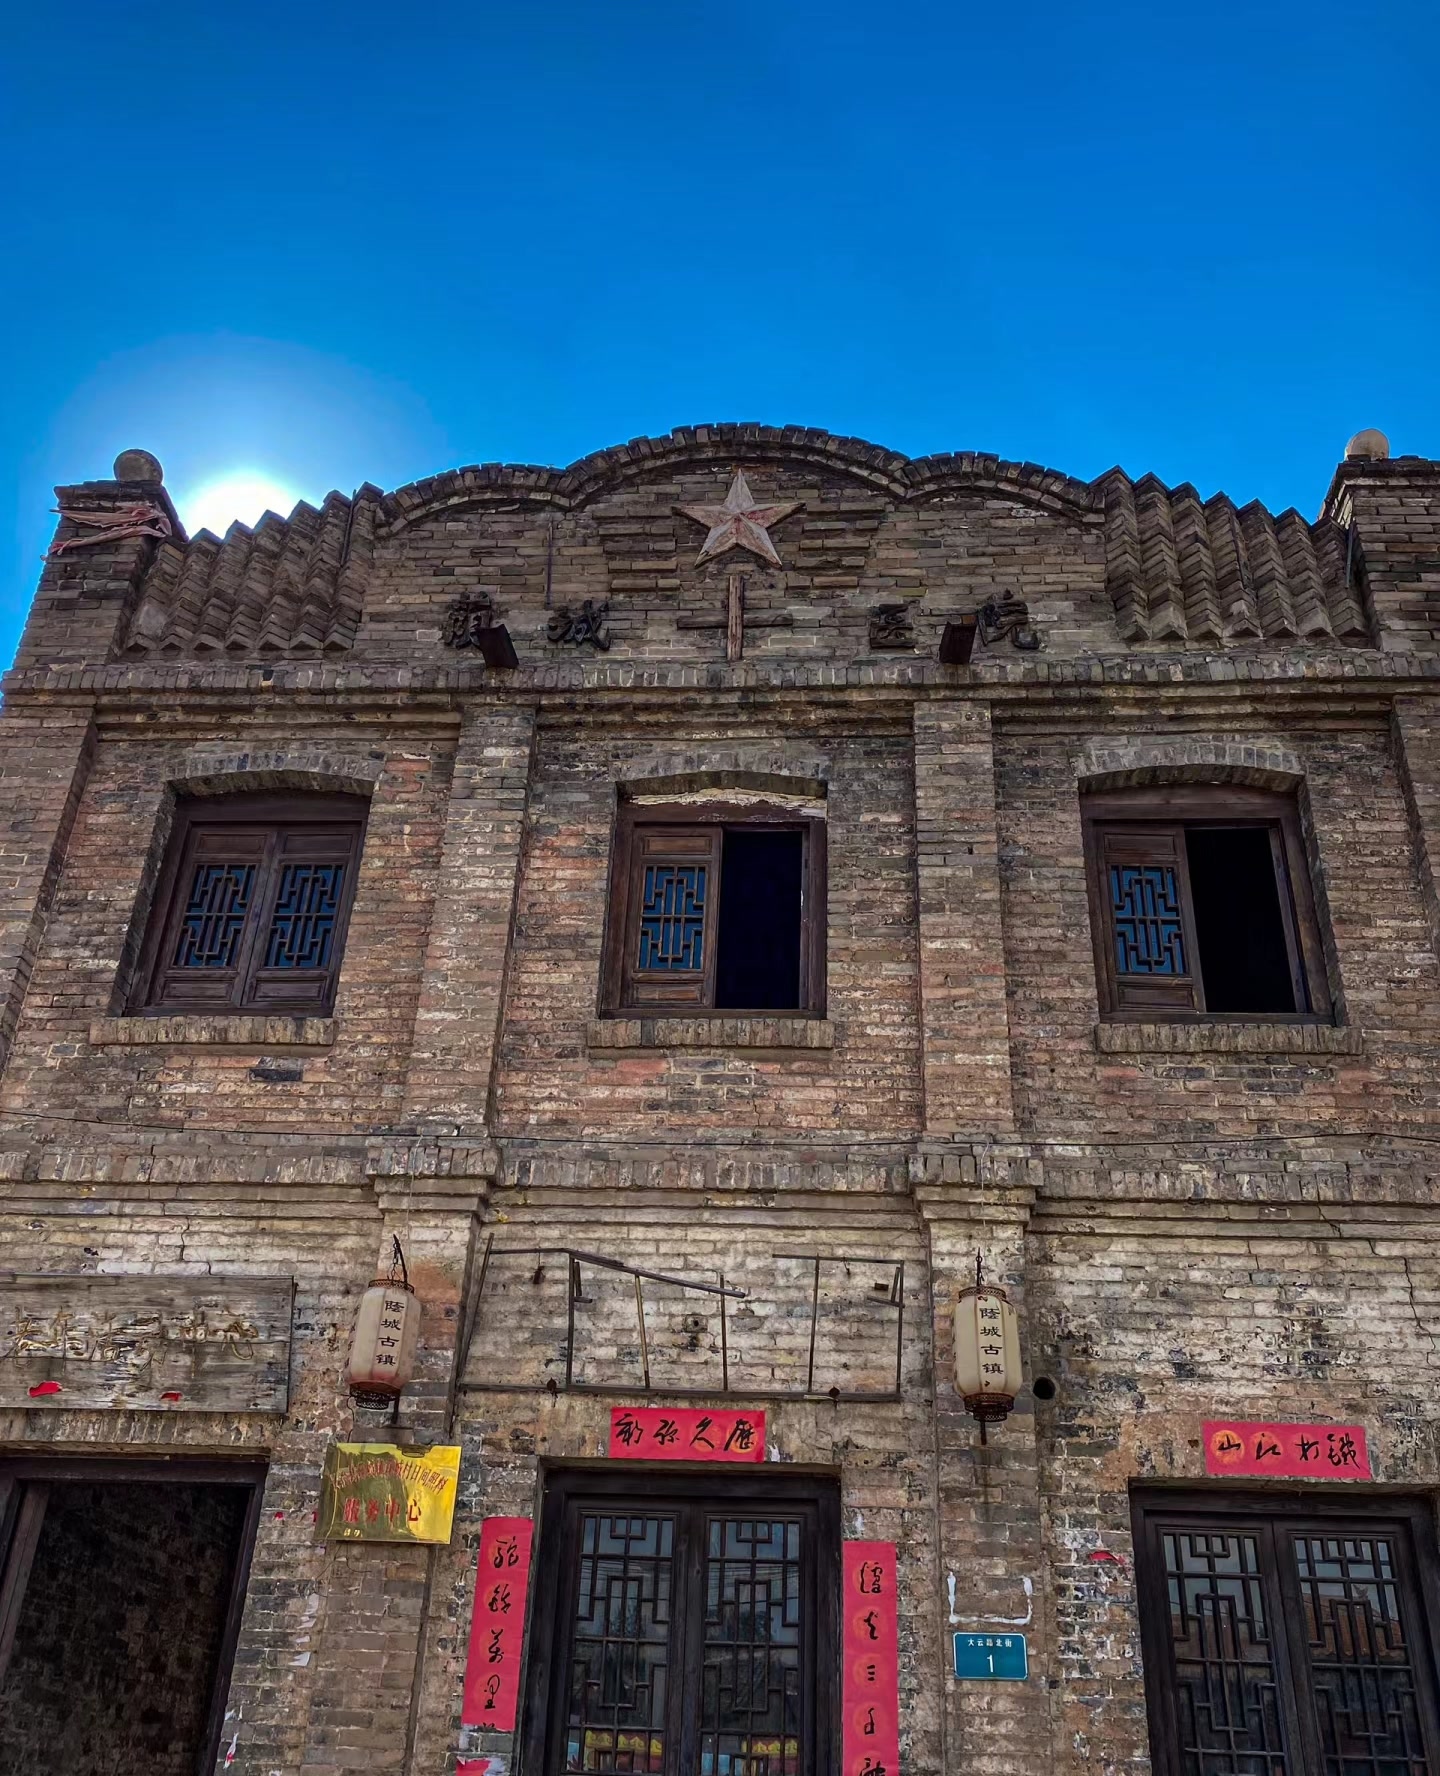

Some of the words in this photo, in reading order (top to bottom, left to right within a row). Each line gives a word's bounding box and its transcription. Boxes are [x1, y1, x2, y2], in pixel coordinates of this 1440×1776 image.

[343, 1497, 422, 1528] 服务中心
[986, 1654, 994, 1673] 1
